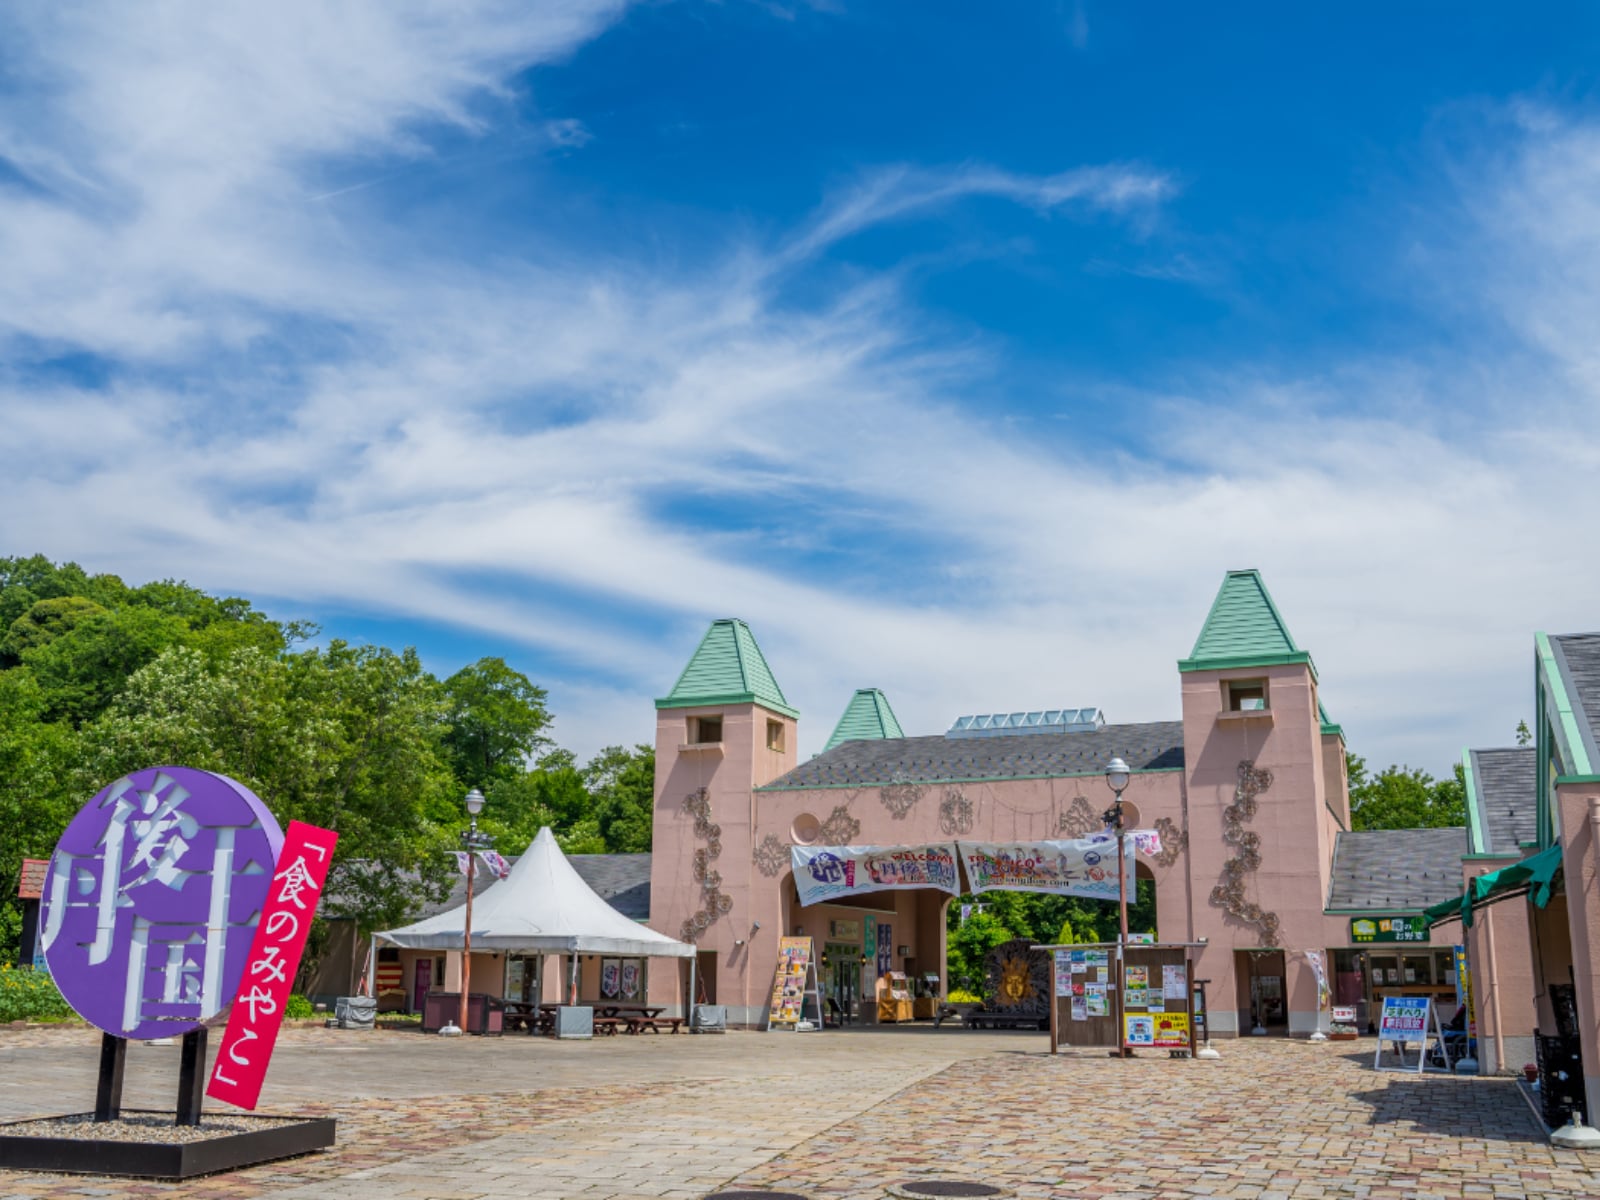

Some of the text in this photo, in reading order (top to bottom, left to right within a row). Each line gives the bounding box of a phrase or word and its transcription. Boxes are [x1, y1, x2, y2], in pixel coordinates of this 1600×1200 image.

[215, 841, 326, 1086] 「食のみやこ」
